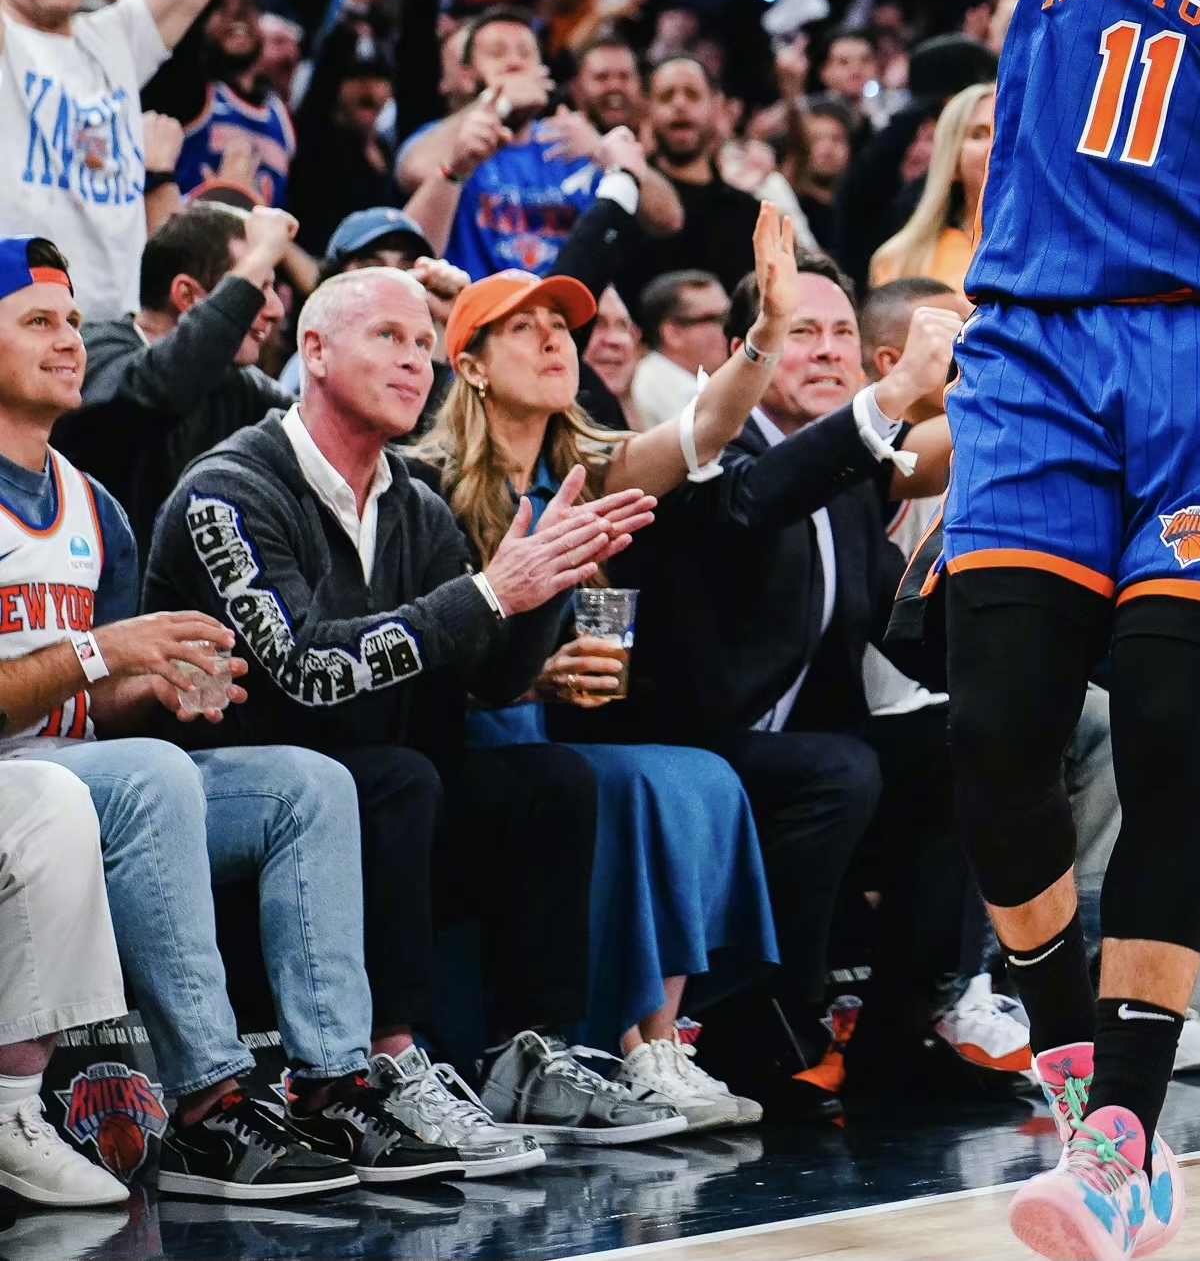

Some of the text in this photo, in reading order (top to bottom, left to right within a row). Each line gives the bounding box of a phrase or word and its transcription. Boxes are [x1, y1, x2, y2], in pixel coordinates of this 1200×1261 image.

[1076, 20, 1187, 167] 11
[0, 583, 95, 634] EW YOR
[133, 1026, 150, 1044] SEA
[68, 1075, 167, 1130] KNICKS
